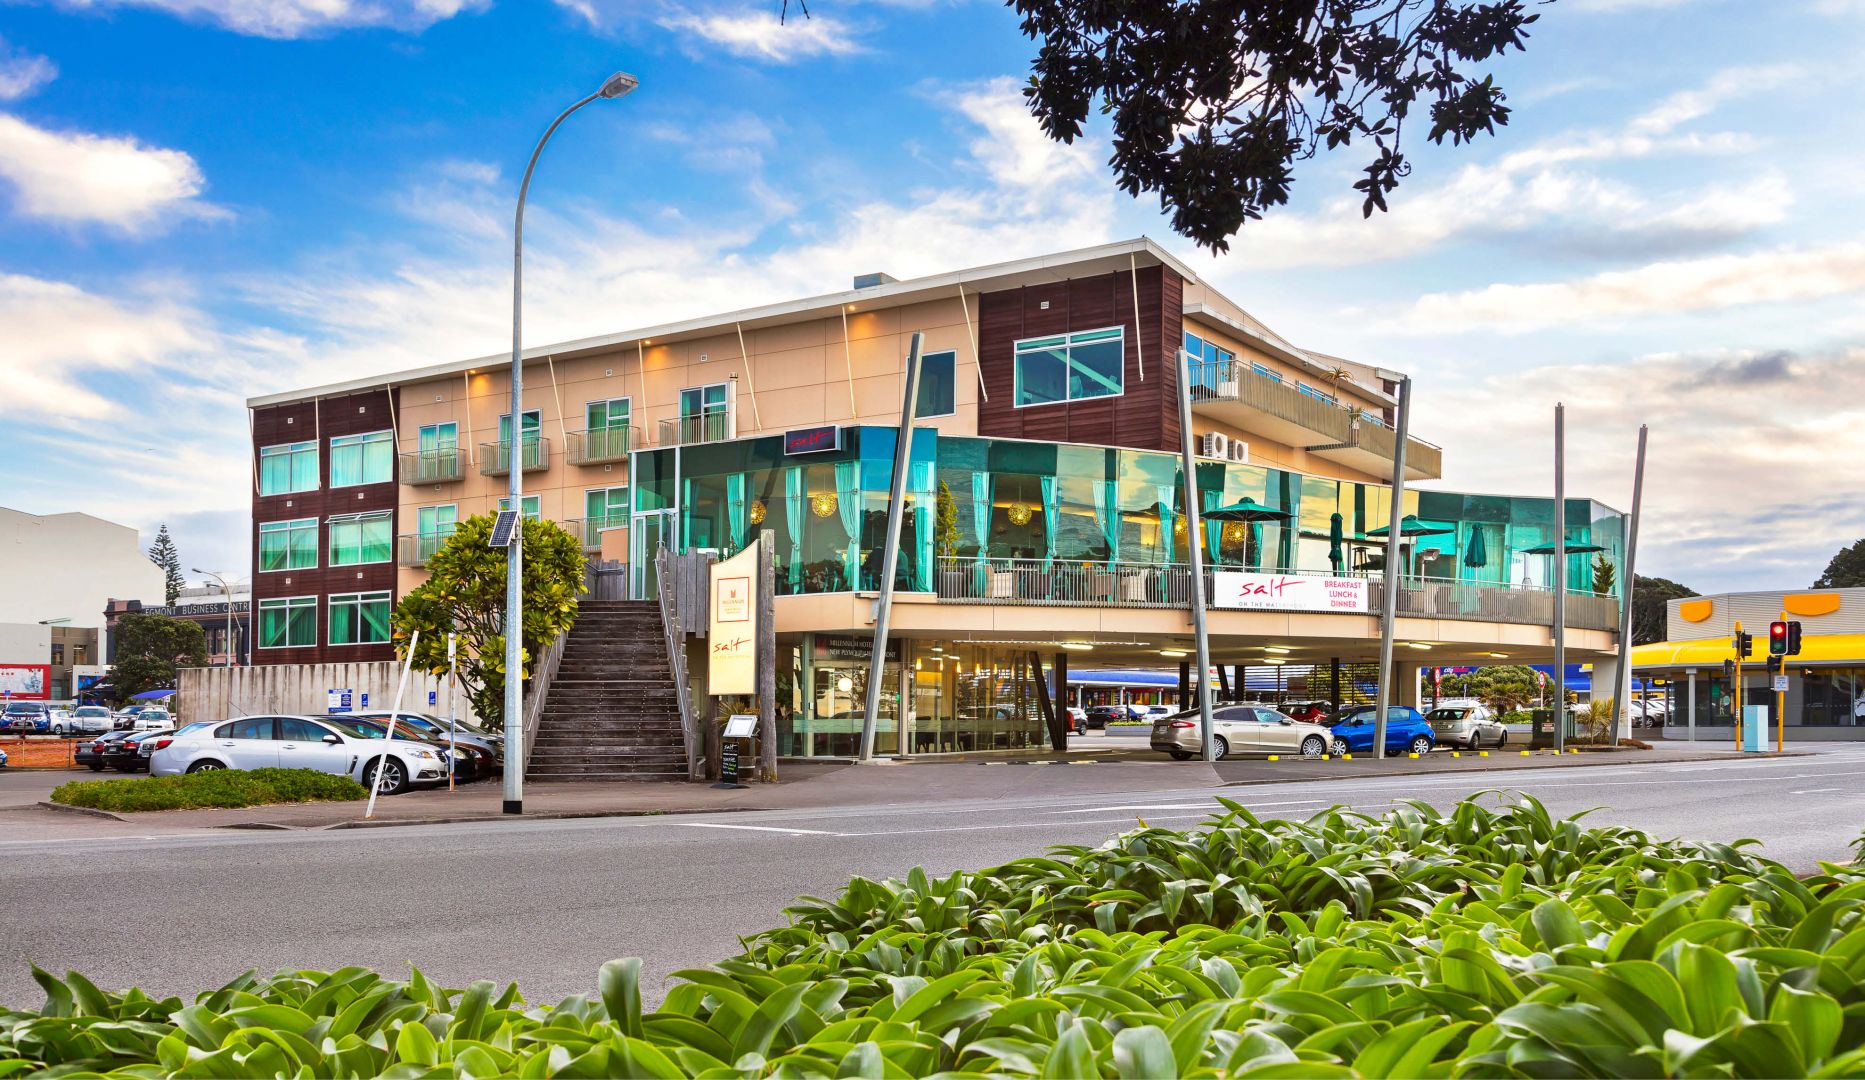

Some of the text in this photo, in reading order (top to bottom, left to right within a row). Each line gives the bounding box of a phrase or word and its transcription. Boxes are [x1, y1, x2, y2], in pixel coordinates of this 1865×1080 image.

[788, 431, 833, 449] salt
[1238, 576, 1306, 597] salt
[1324, 580, 1362, 589] BREAKFAST
[1329, 590, 1353, 599] LUNCH
[182, 603, 218, 615] BUSINESS
[222, 601, 250, 613] CNTR
[1330, 600, 1357, 608] DINNER
[713, 637, 752, 654] salt
[859, 641, 873, 649] HOTE
